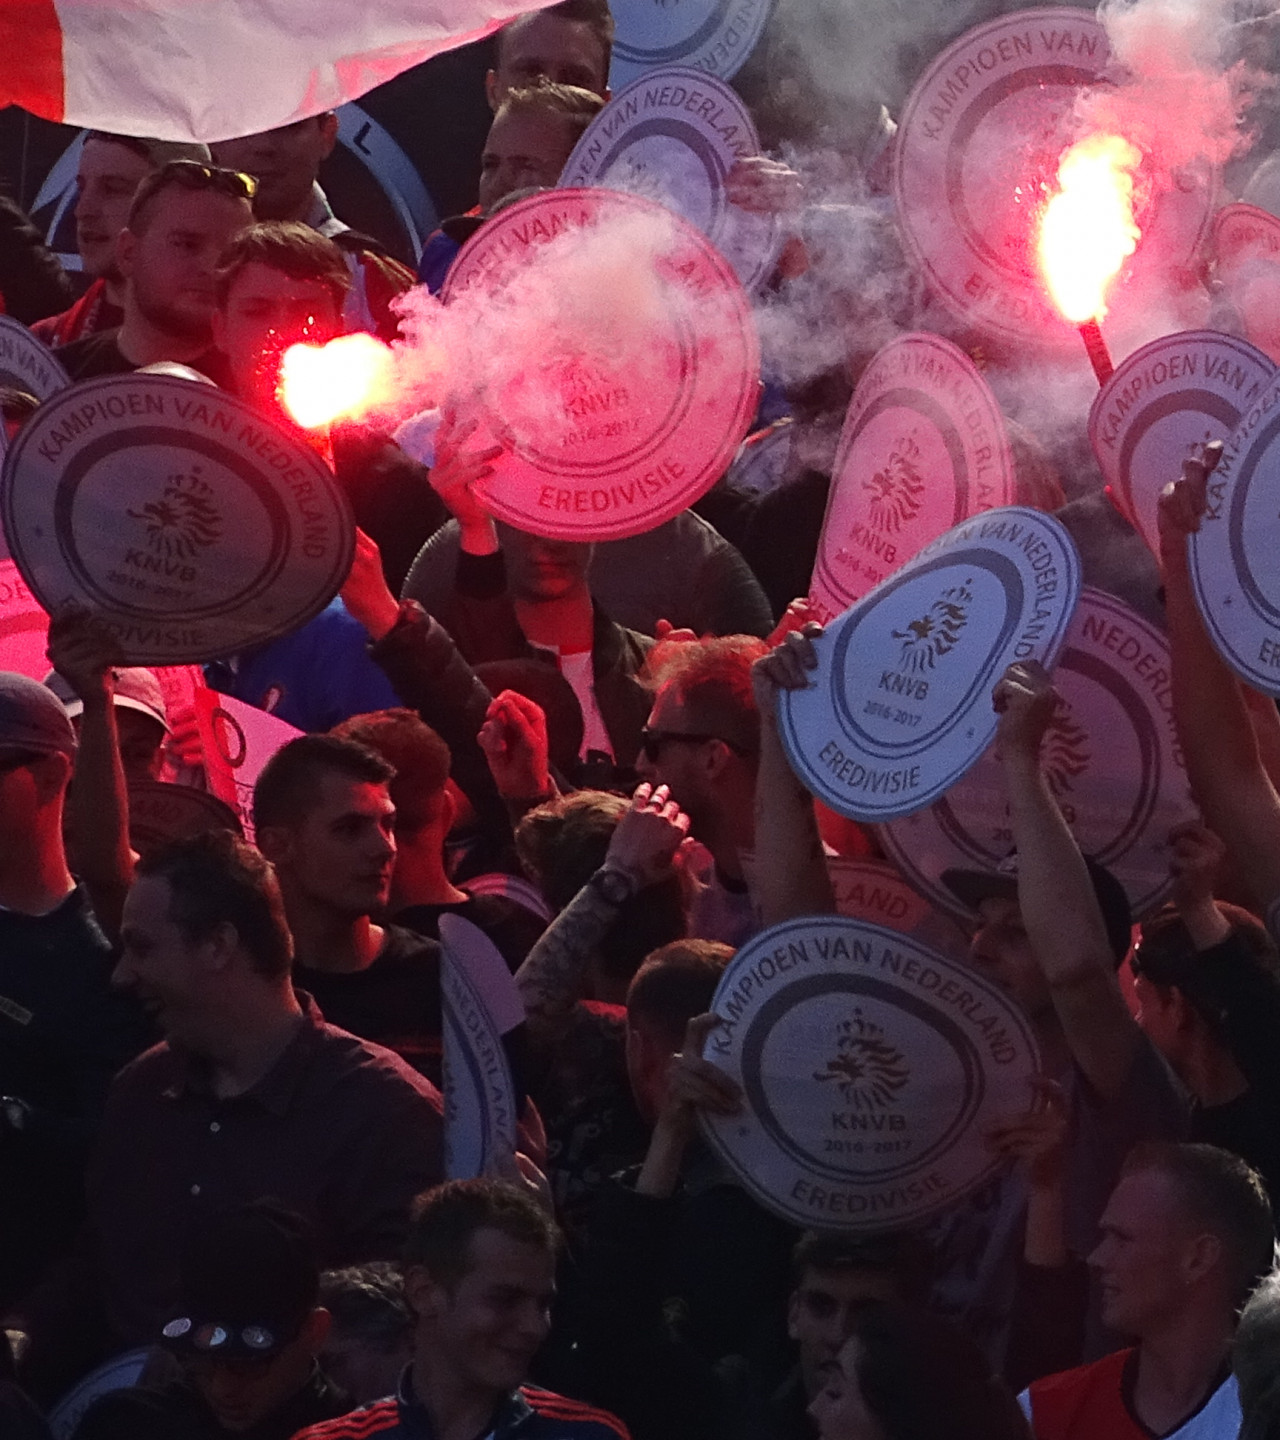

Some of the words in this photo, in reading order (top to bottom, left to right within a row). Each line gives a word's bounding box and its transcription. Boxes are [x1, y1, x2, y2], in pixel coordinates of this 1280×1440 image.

[922, 30, 1034, 141] KAMPIOEN
[1038, 29, 1098, 58] VAN
[602, 97, 639, 140] VAN
[643, 85, 748, 159] NEDERLAN
[1101, 353, 1199, 450] KAMPIOEN
[1203, 358, 1255, 391] VAN
[38, 392, 164, 463] KAMPIOEN
[174, 397, 235, 432] VAN
[237, 424, 331, 560] NEDERLAND
[536, 458, 687, 514] EREDIVISIE
[124, 547, 198, 583] KNVB
[850, 521, 898, 565] KNVB
[980, 521, 1024, 547] VAN
[1013, 530, 1059, 659] NEDERLAND
[877, 670, 931, 702] KNVB
[862, 700, 923, 728] 2016-2017
[818, 739, 921, 794] EREDIVISIE
[711, 939, 810, 1056] KAMPIOEN
[813, 936, 873, 962] VAN
[880, 947, 1017, 1065] NEDERLAND
[452, 978, 507, 1137] NEDERLAN
[824, 1137, 914, 1154] 2016-2017
[832, 1114, 907, 1132] KNVB
[790, 1170, 950, 1214] EREDIVISIE
